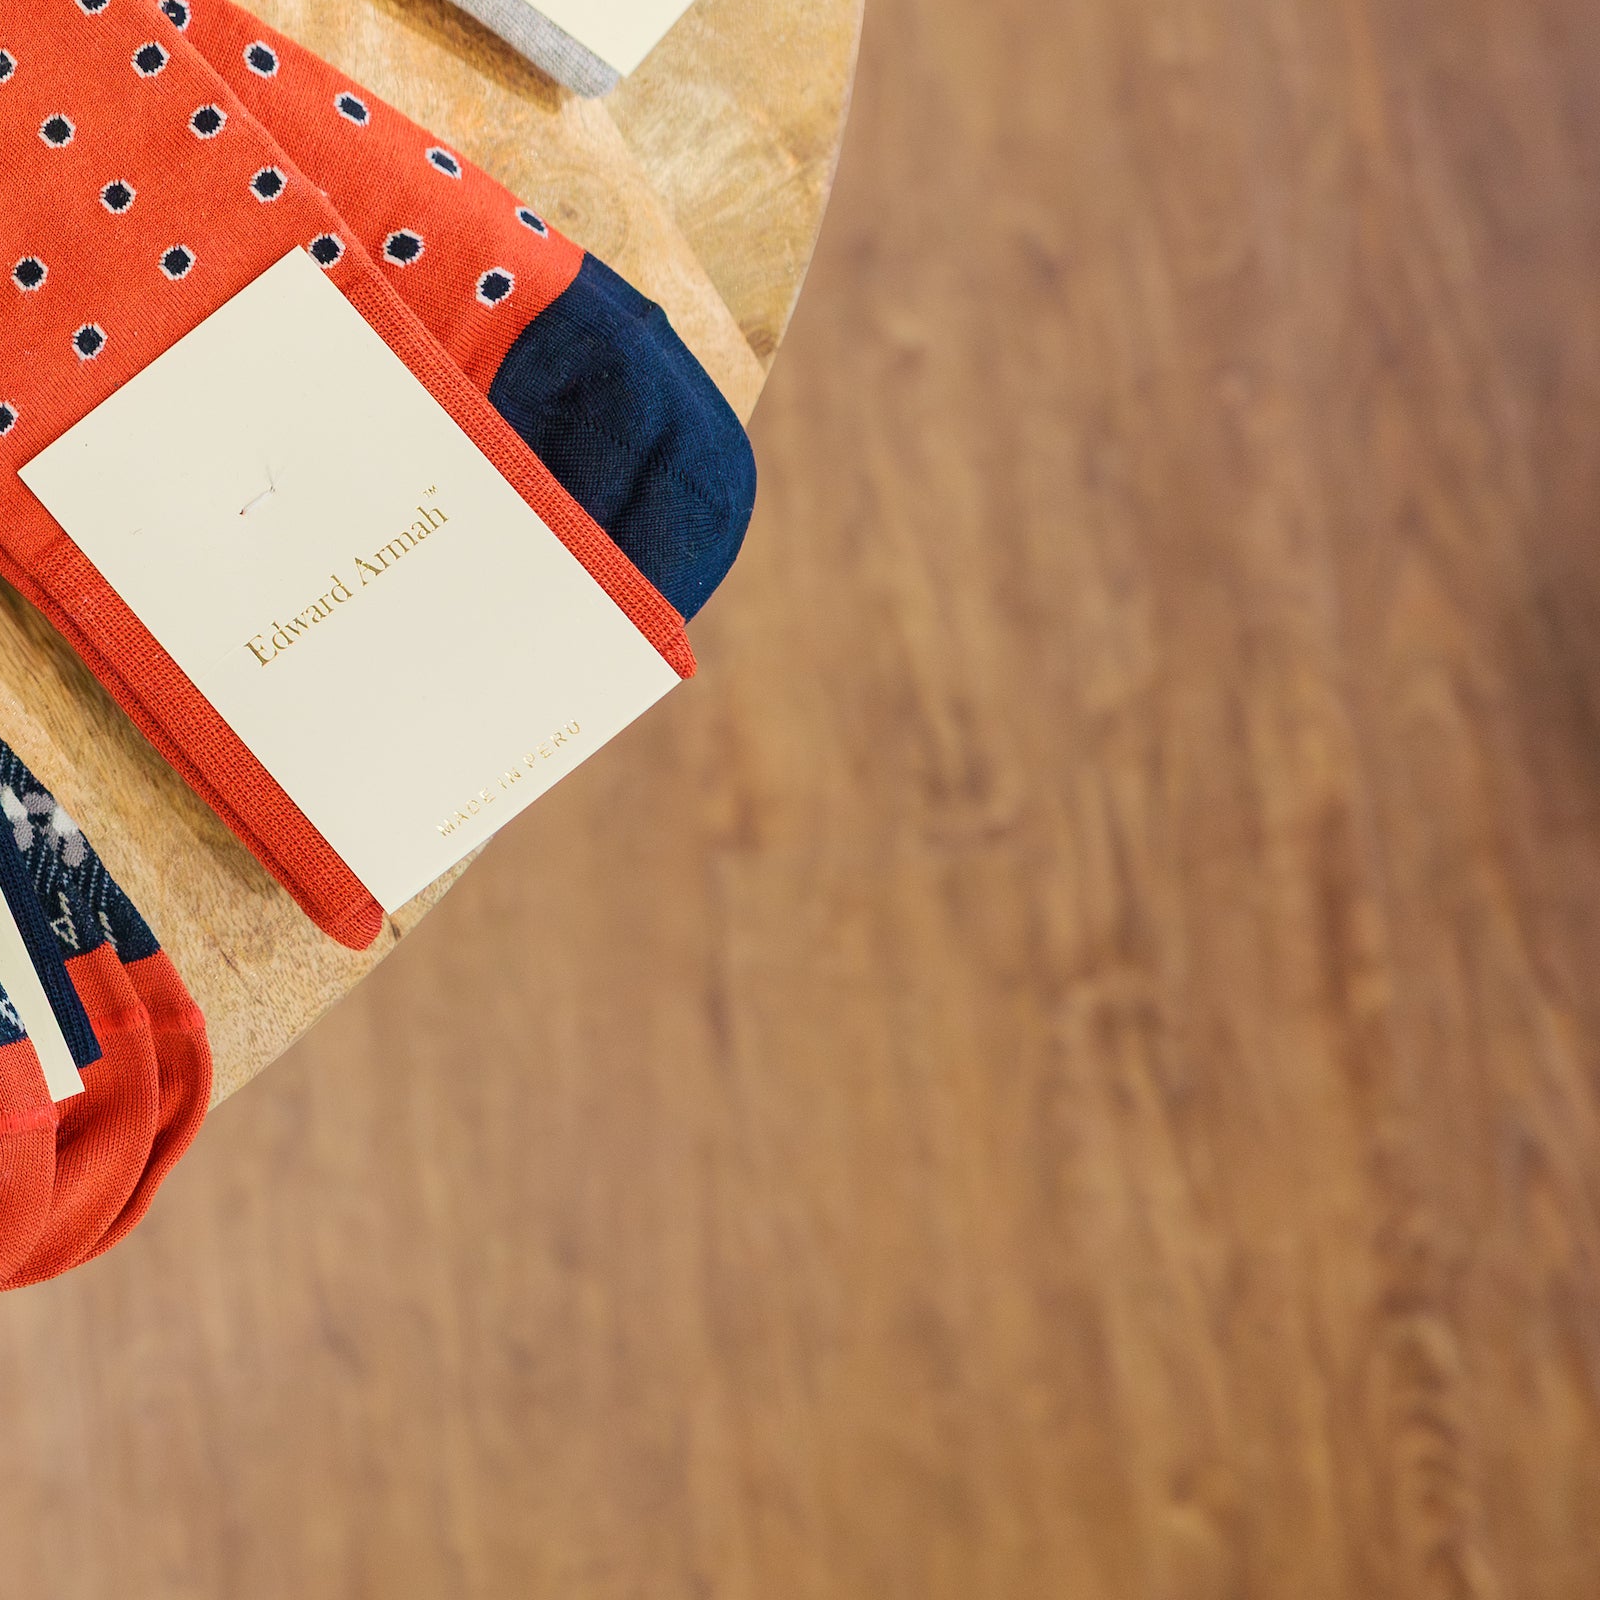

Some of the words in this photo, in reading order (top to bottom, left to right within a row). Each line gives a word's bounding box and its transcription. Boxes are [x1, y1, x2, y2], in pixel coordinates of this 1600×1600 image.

[243, 573, 355, 668] Edward
[436, 787, 497, 837] MADE
[497, 767, 522, 790] IN
[522, 719, 581, 770] PERU
